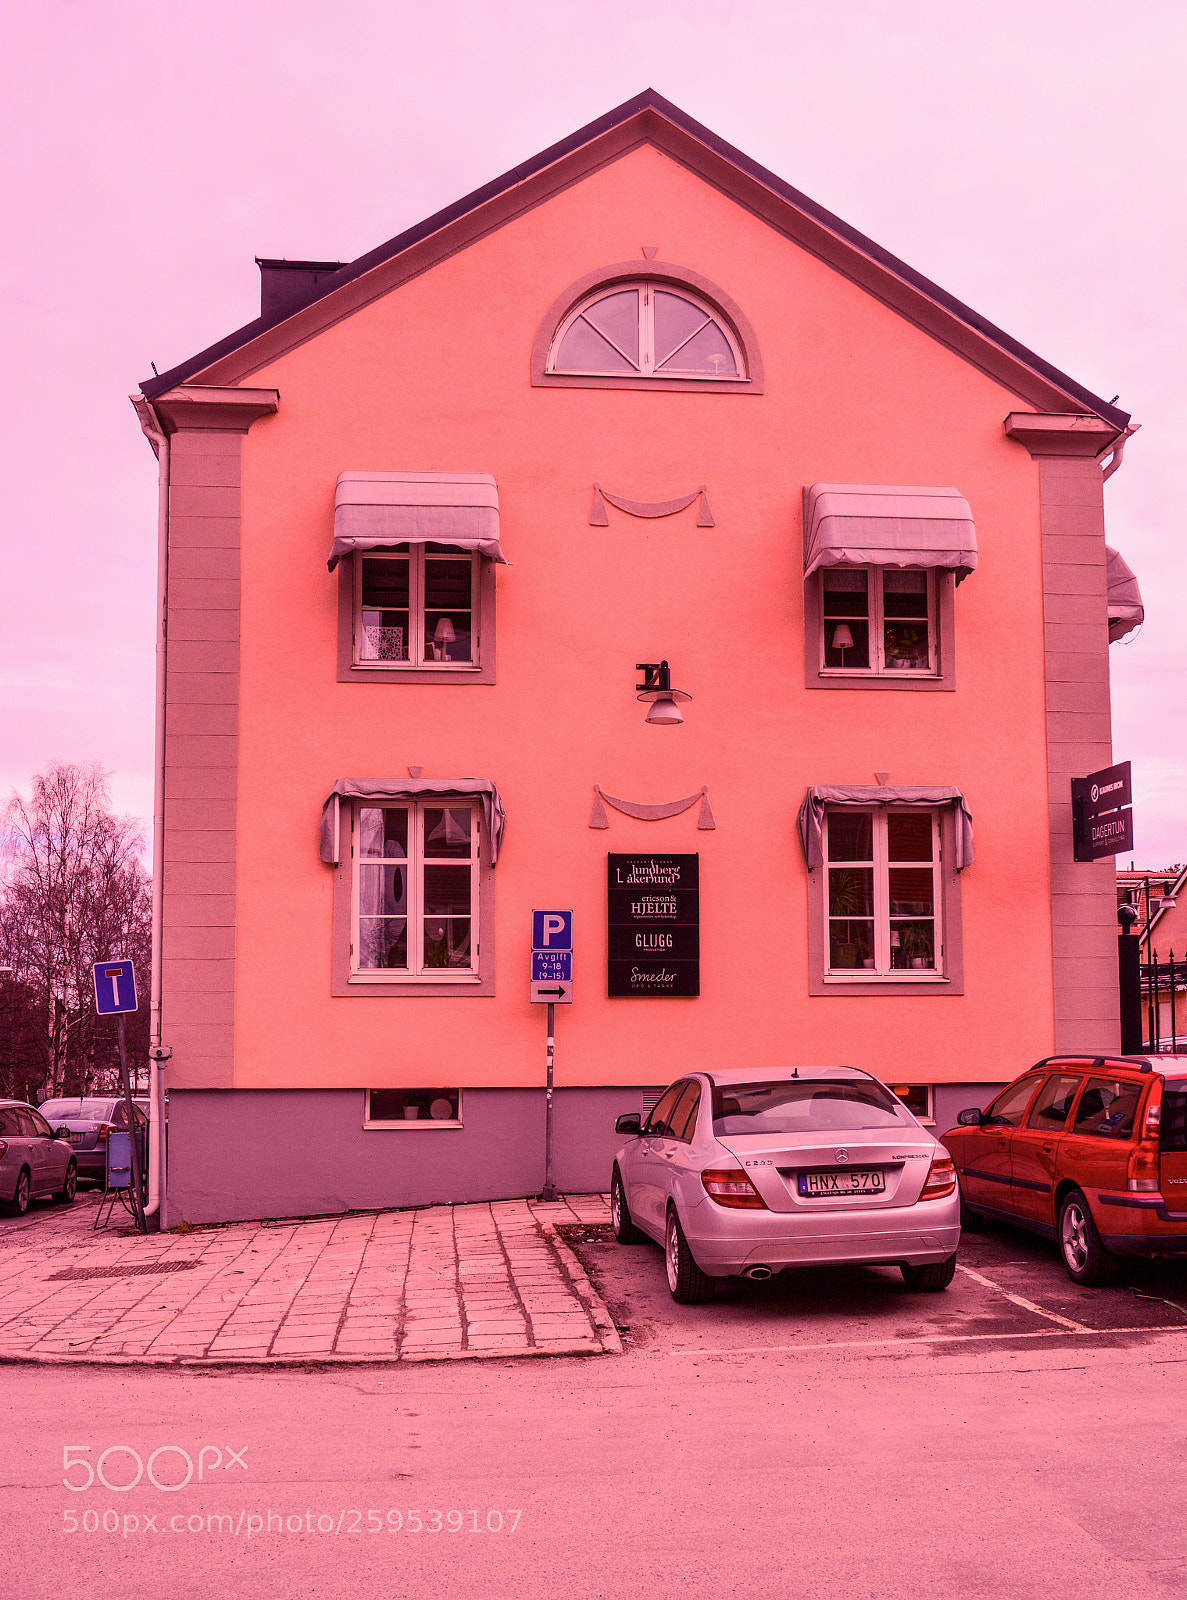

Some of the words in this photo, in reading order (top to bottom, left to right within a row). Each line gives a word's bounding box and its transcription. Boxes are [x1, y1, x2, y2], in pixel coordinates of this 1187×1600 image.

[1091, 820, 1125, 841] DAGERTUN
[631, 902, 678, 915] HJELTE
[543, 914, 566, 946] P
[635, 933, 673, 948] GLUGG
[537, 953, 567, 962] Avgift
[541, 962, 562, 970] 9-18
[538, 971, 565, 980] (9-15)
[630, 966, 678, 982] Smeder
[809, 1175, 839, 1190] HNX
[850, 1173, 881, 1188] 570
